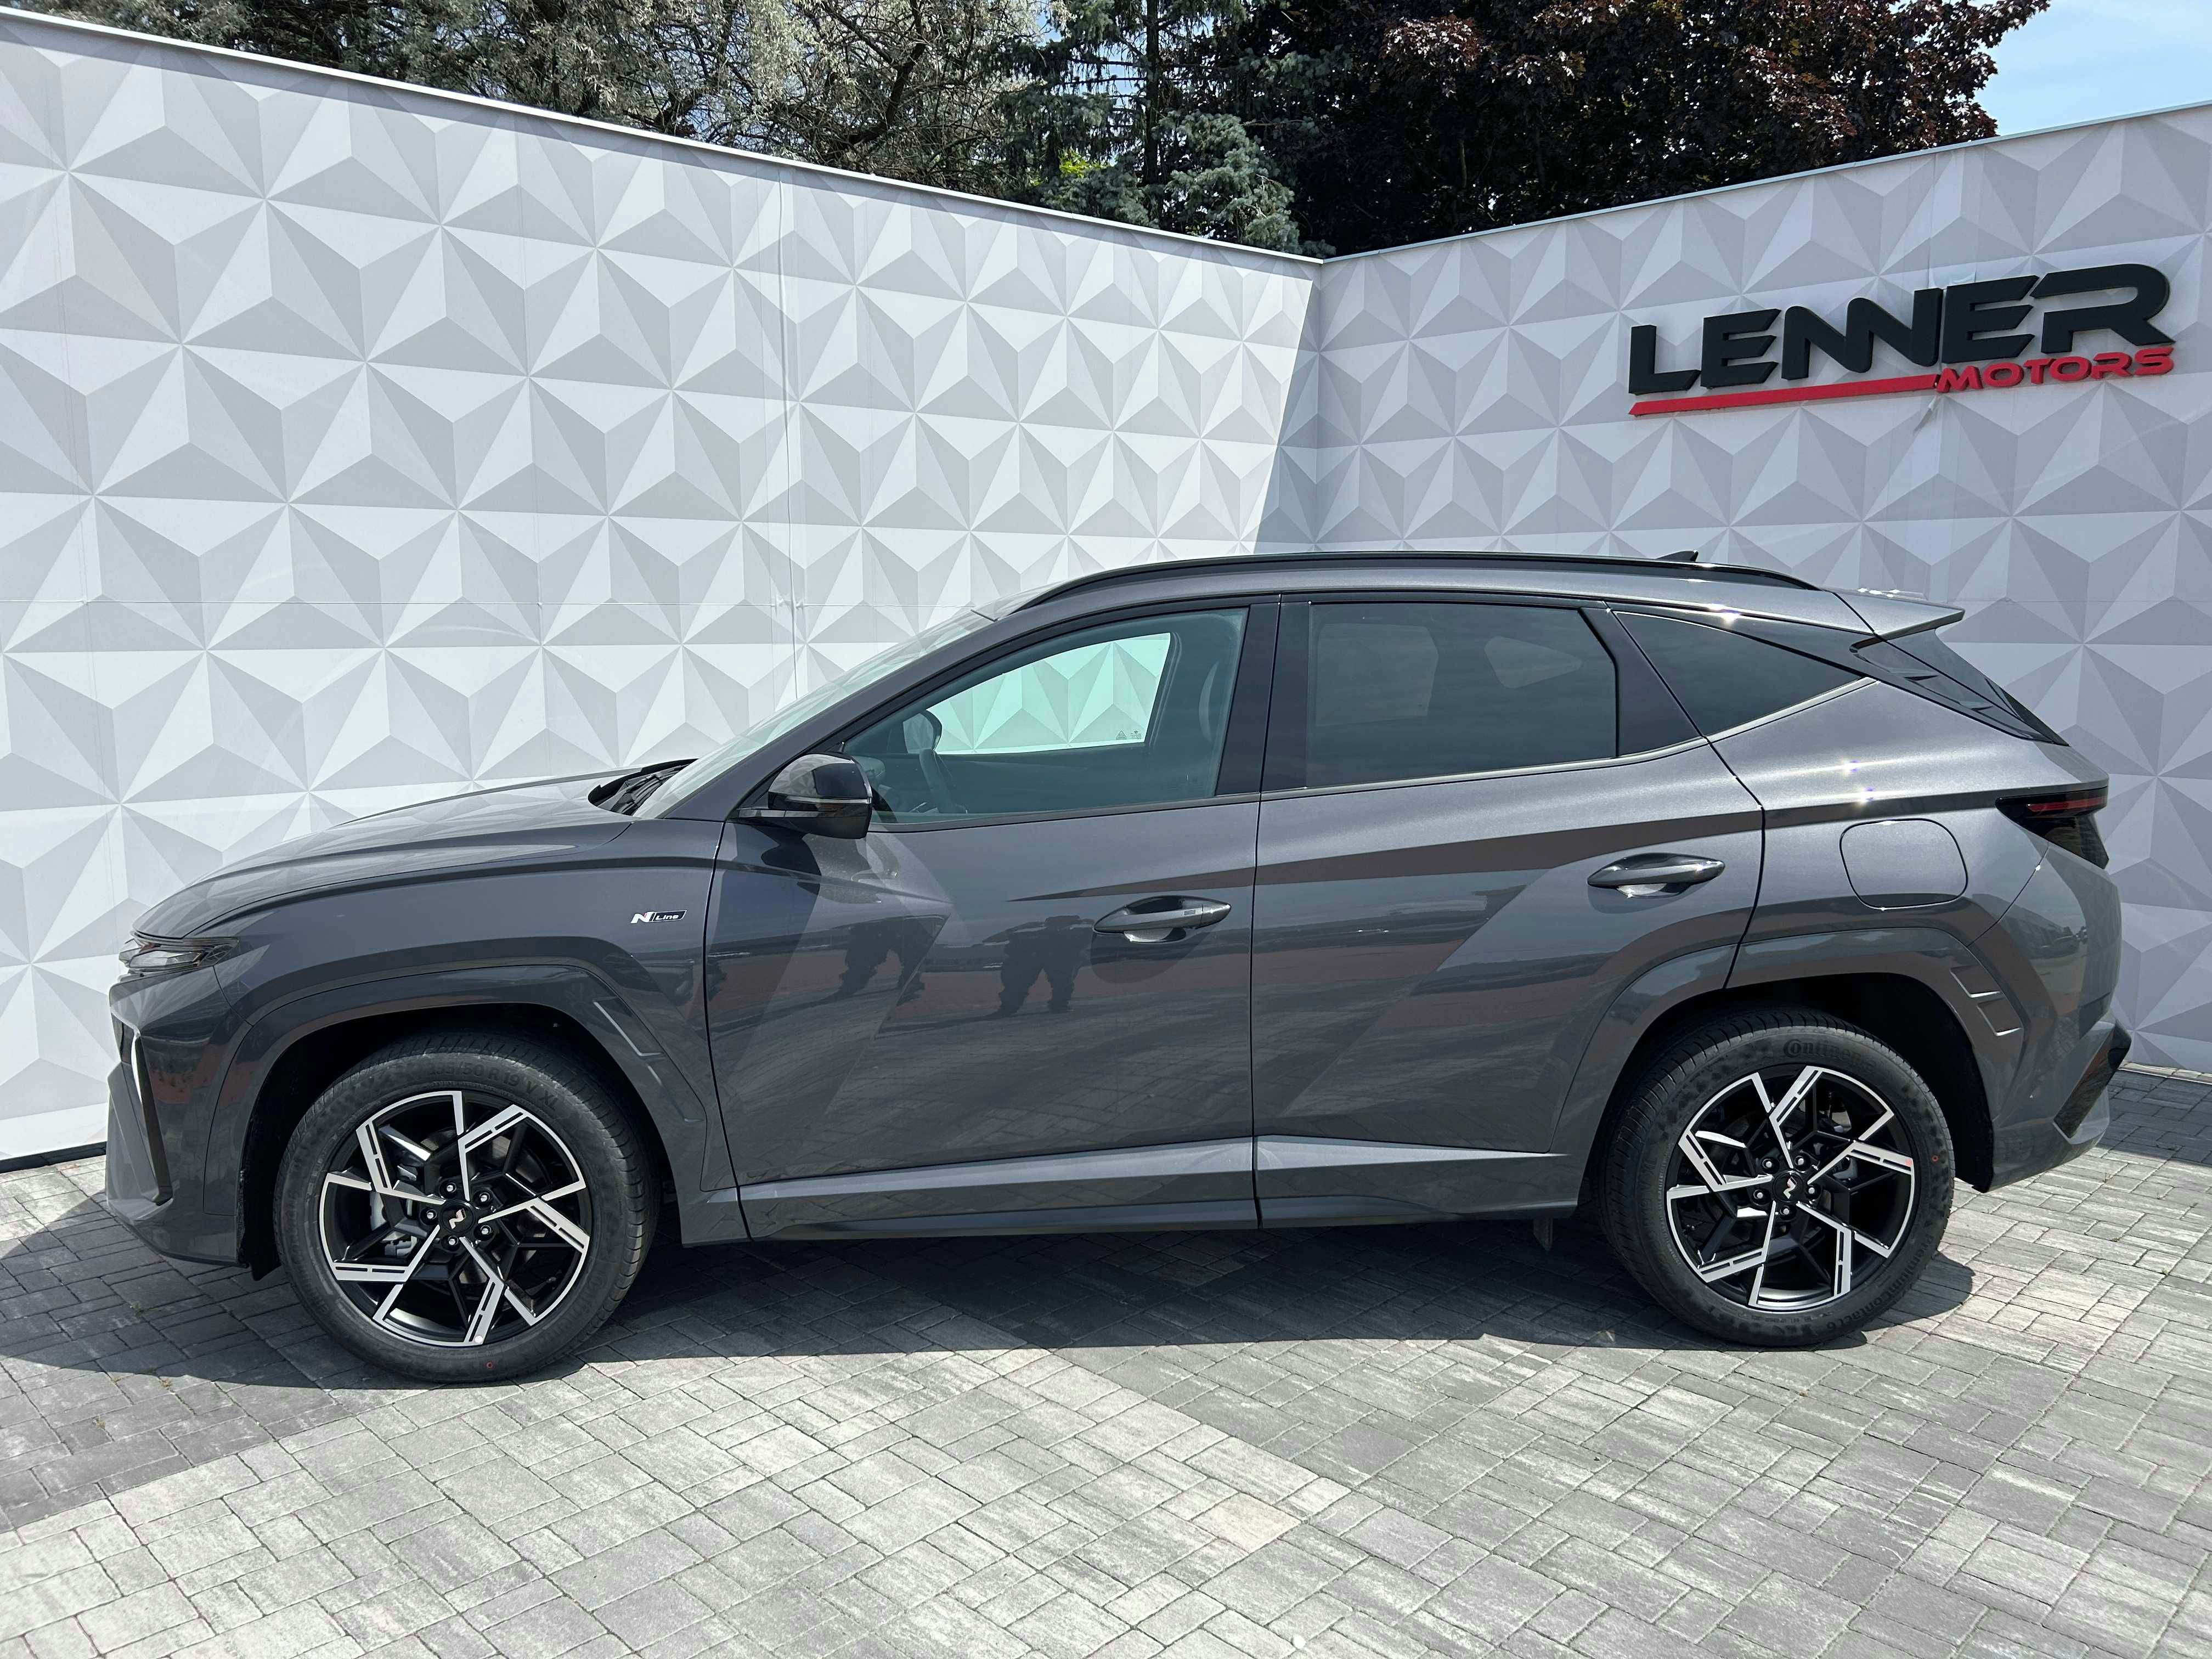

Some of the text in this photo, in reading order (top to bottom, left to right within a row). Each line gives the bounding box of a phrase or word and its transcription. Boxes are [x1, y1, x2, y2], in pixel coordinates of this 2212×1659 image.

[1629, 263, 2175, 394] LENNER
[1936, 347, 2174, 392] MOTORS
[630, 911, 655, 923] N
[503, 1072, 520, 1086] 19
